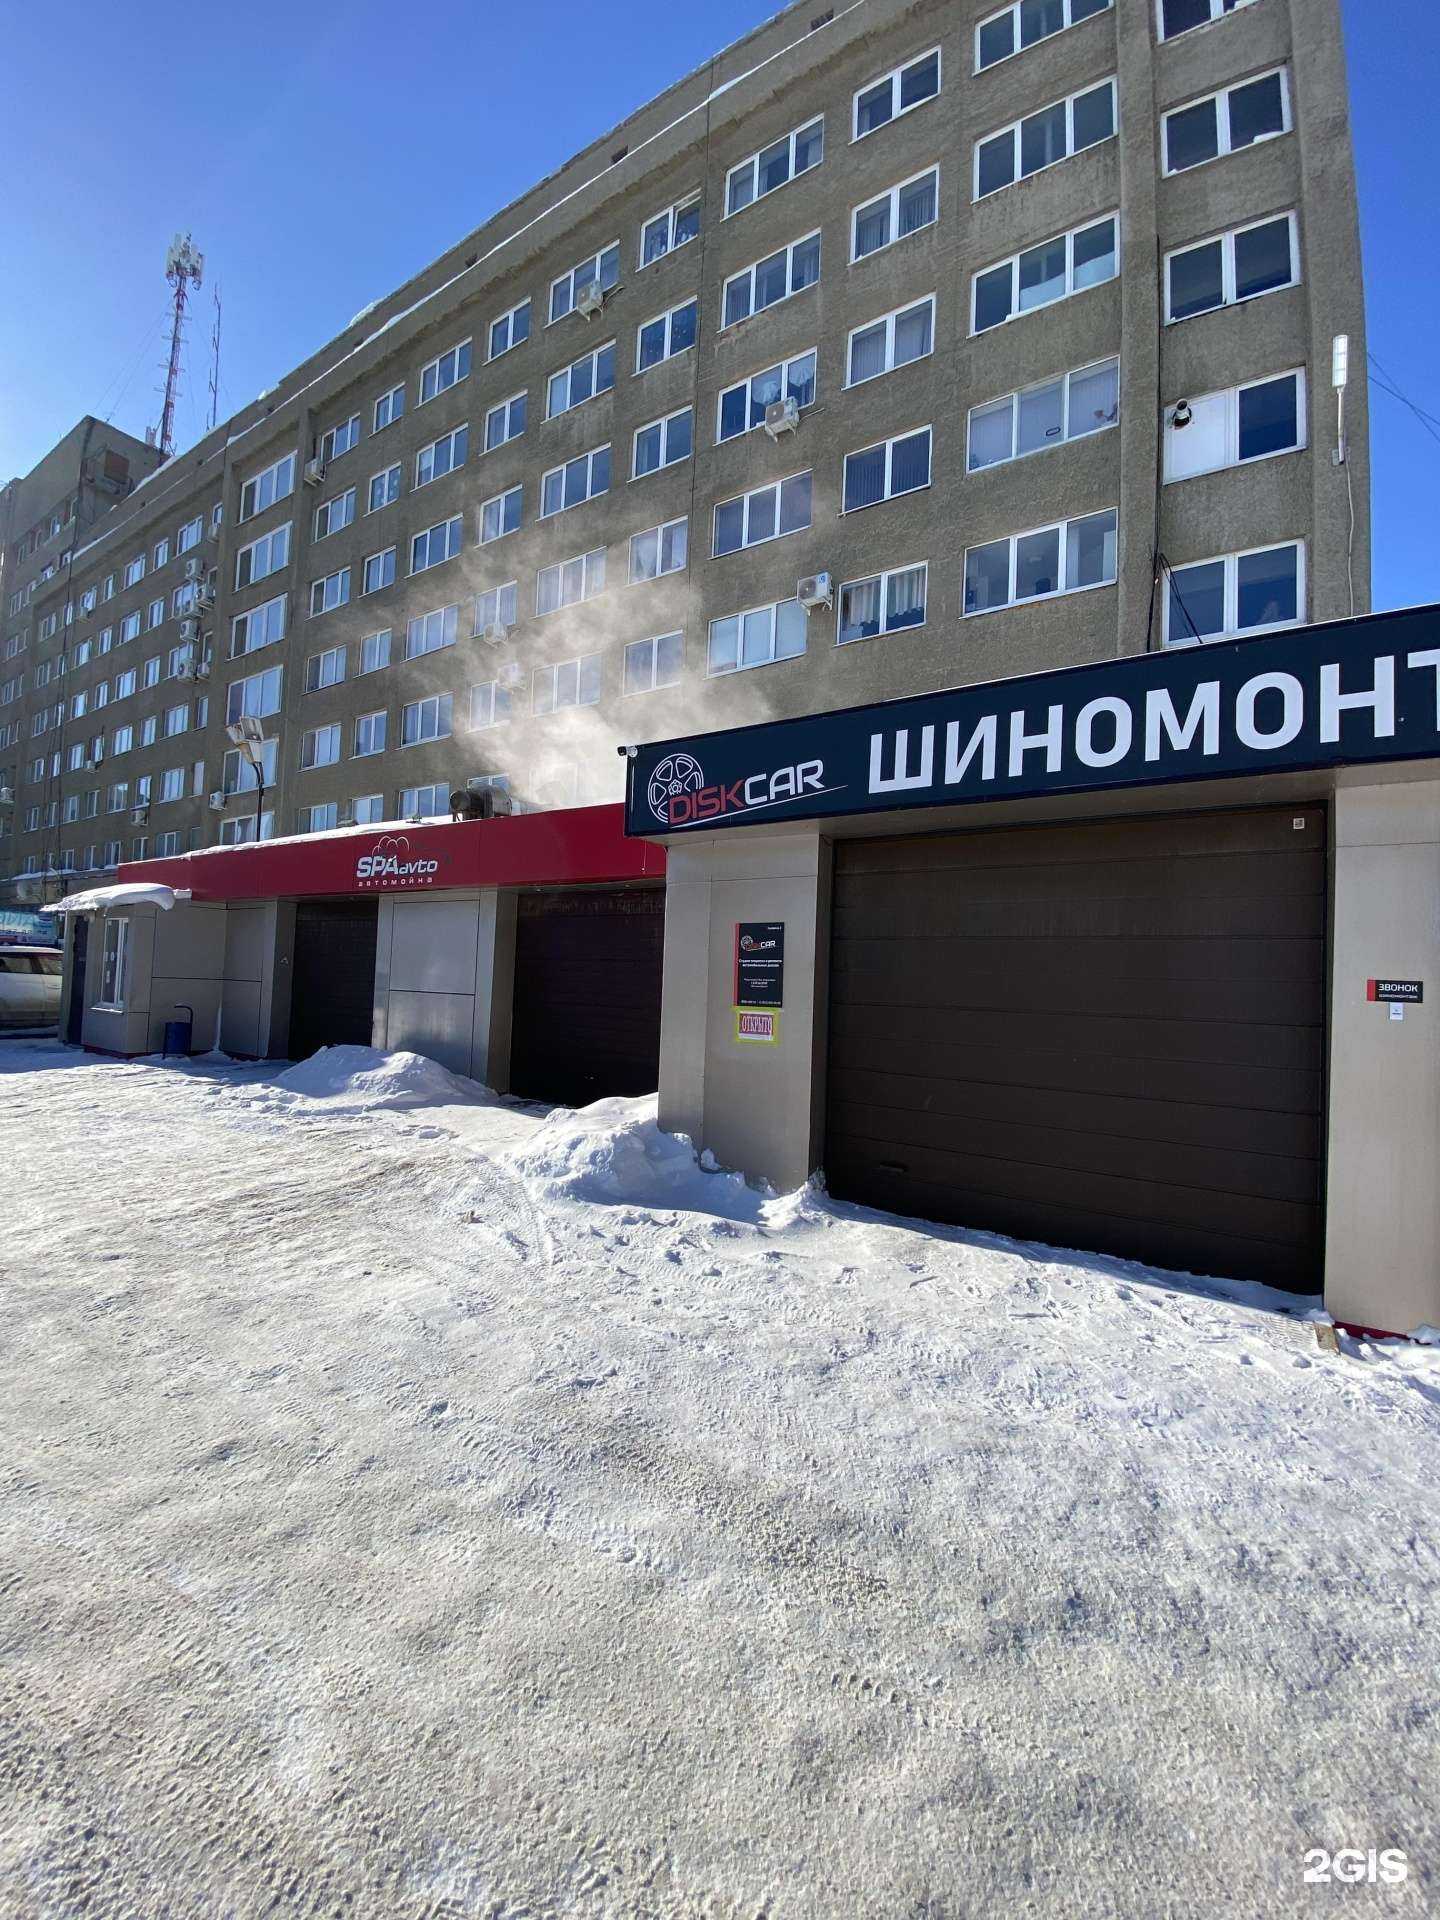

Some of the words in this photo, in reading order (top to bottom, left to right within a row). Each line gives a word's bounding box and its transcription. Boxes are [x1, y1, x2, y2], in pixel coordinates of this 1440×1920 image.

[668, 759, 825, 825] DISKCAR
[1378, 983, 1418, 992] ЗВОНОК
[742, 1015, 773, 1035] ОТКРЫТО
